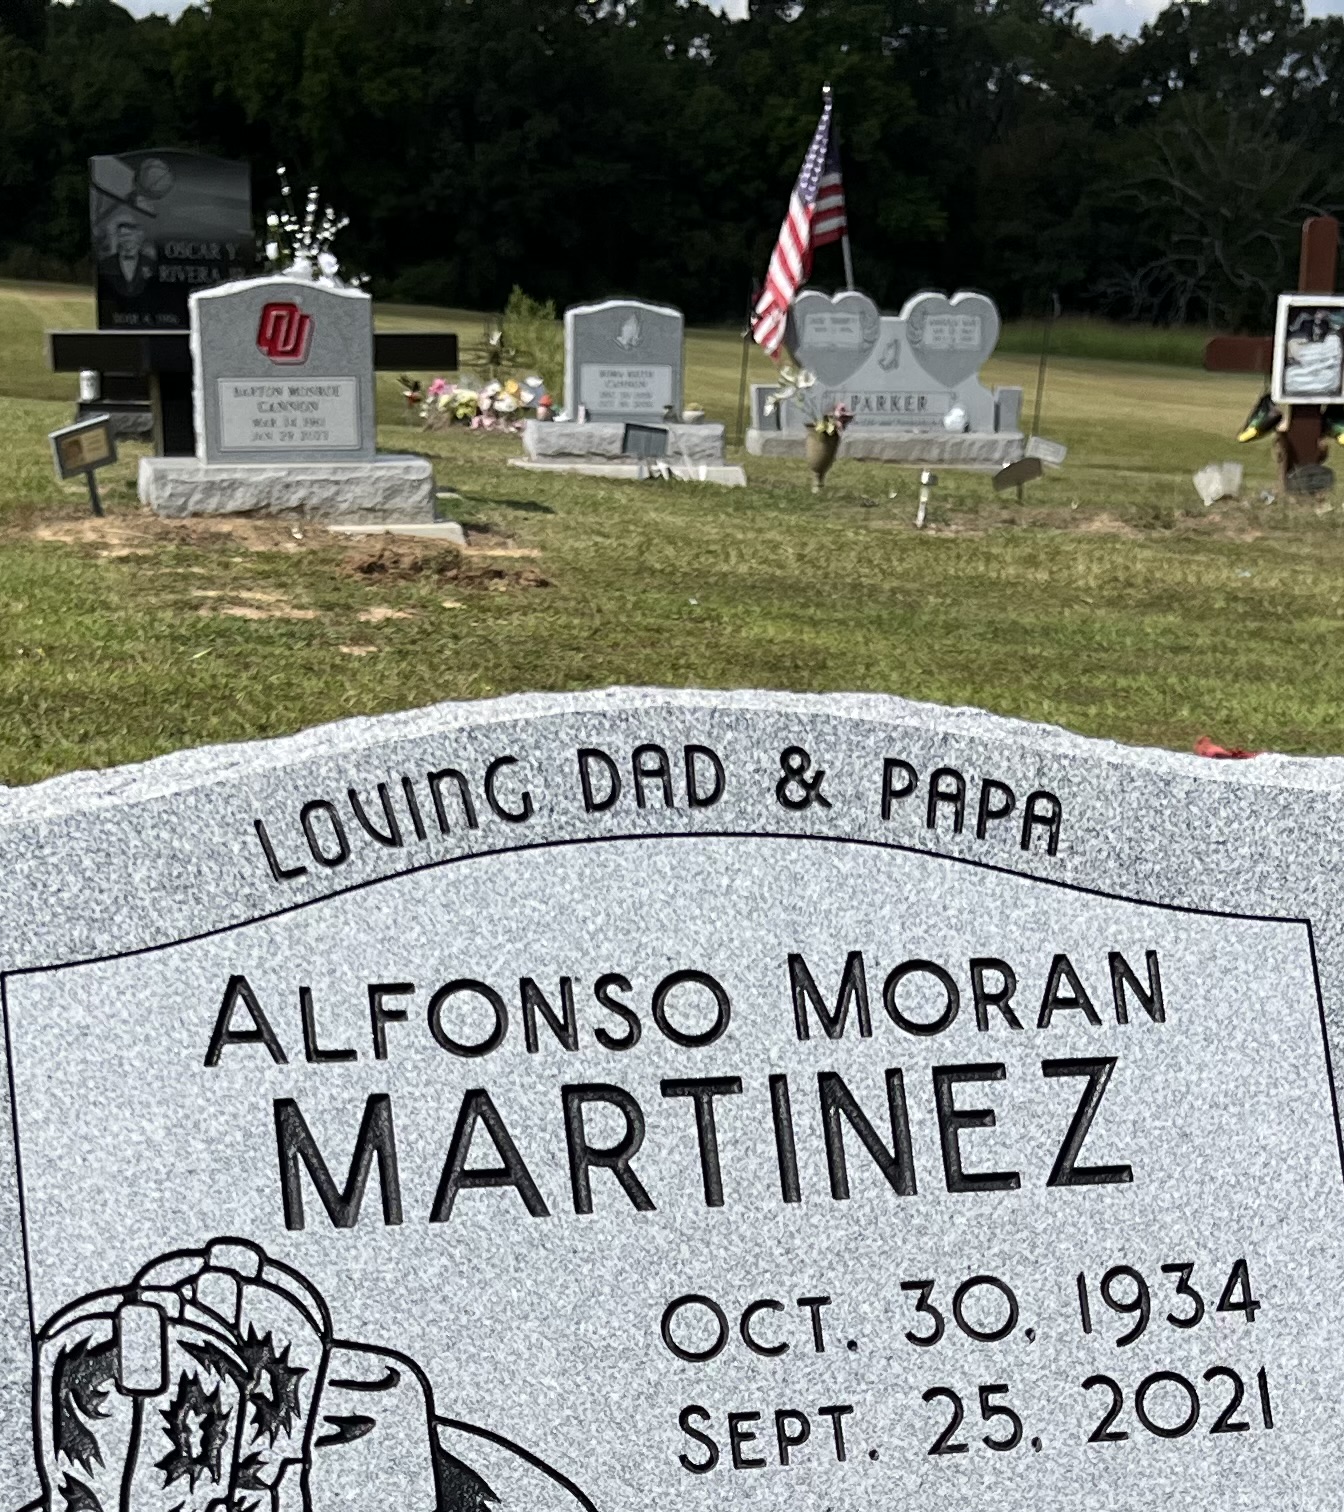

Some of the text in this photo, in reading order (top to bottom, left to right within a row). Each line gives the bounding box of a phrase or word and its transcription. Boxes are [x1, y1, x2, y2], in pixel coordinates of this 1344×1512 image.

[850, 394, 929, 414] PARKER
[253, 742, 1064, 882] LOVING DAD & PAPA
[203, 948, 1167, 1068] ALFONSO MORAN
[272, 1055, 1135, 1232] MARTINEZ
[659, 1293, 858, 1363] OCT.
[1076, 1257, 1262, 1348] 1934
[677, 1403, 881, 1475] SEPT.
[1081, 1364, 1275, 1444] 2021
